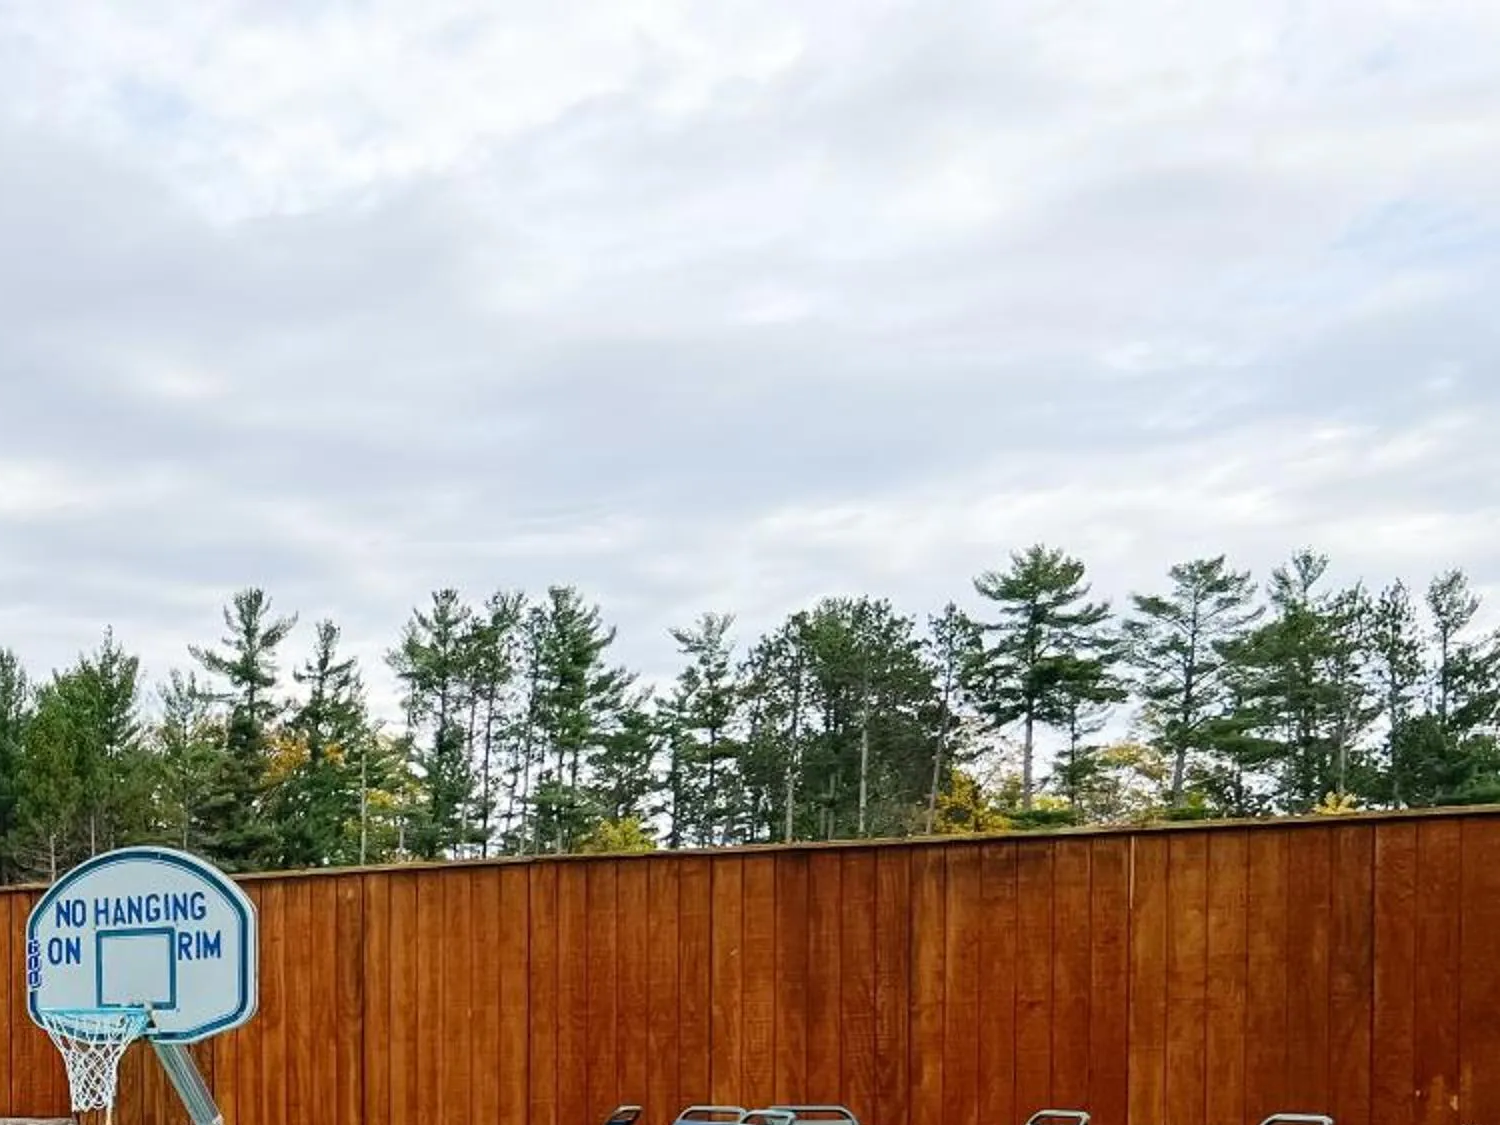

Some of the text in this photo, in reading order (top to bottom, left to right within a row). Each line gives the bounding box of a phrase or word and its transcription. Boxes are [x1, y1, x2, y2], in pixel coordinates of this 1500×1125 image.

[55, 891, 208, 928] NO HANGING
[47, 936, 82, 965] ON
[177, 929, 222, 961] RIM
